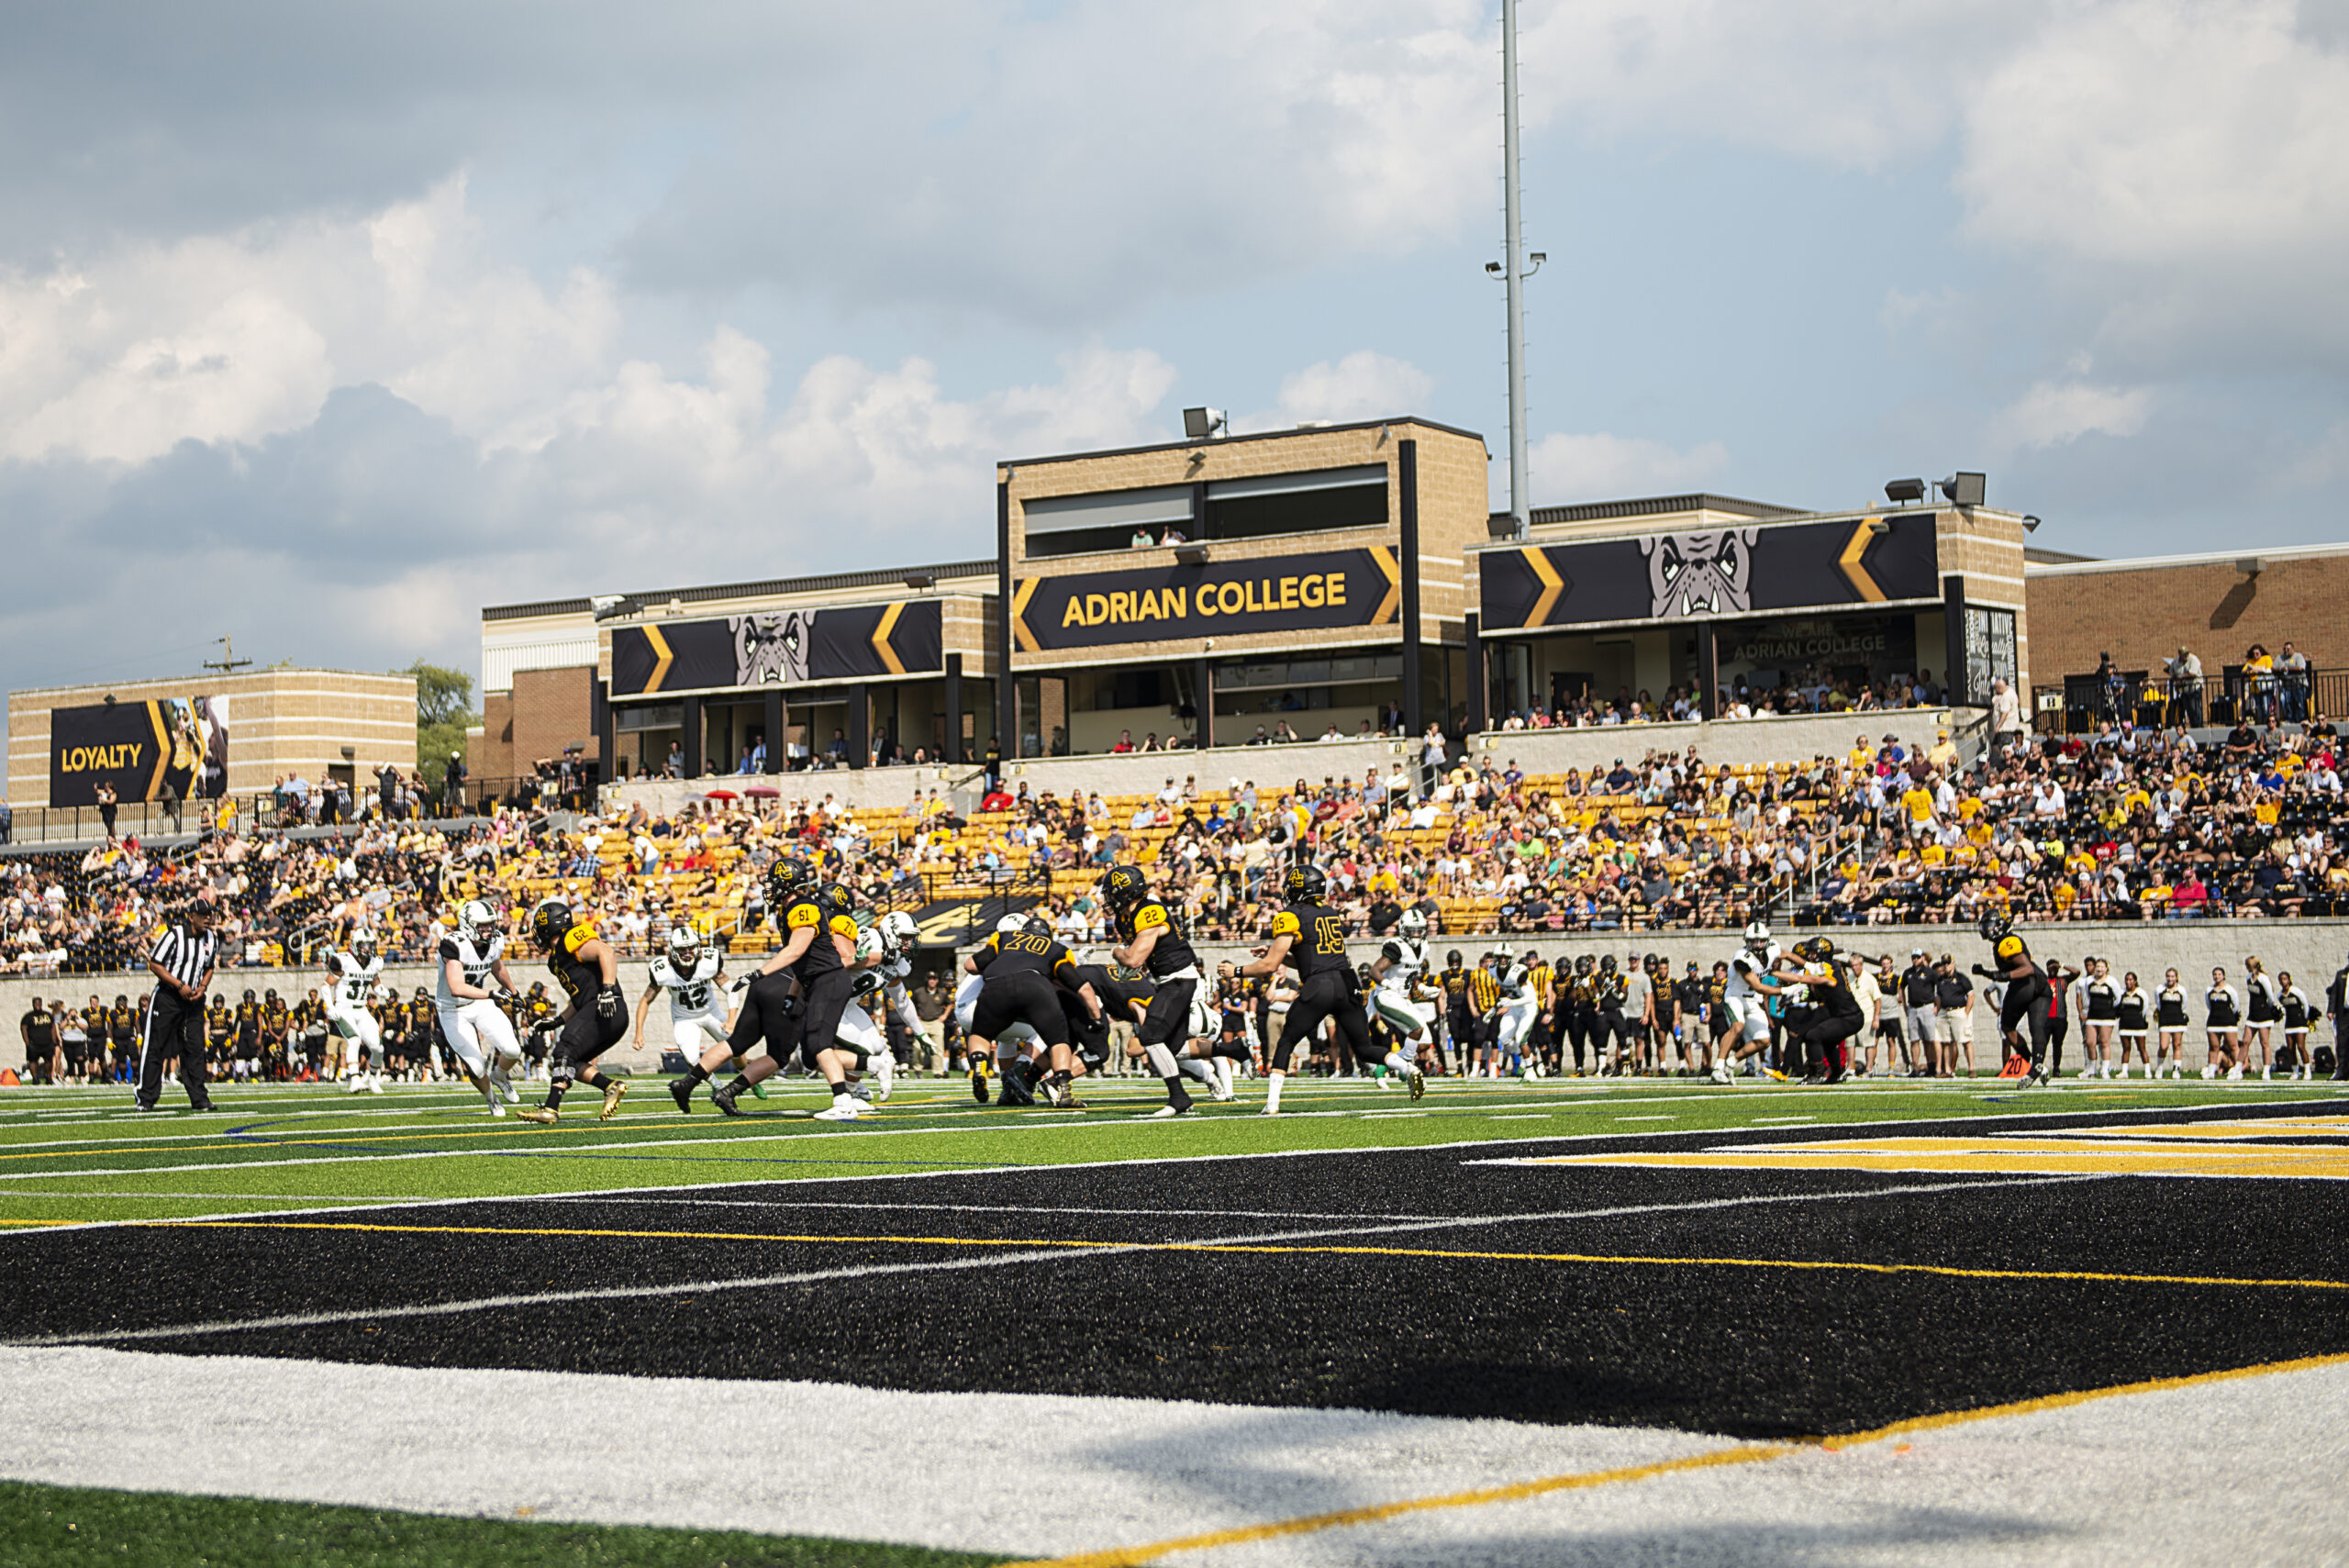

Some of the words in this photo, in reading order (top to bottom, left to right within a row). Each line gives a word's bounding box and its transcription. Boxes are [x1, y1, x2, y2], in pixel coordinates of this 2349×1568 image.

[1062, 586, 1186, 628] ADRIAN
[1195, 572, 1346, 617] COLLEGE
[1781, 622, 1801, 639] WE
[1807, 621, 1832, 637] ARE
[1733, 642, 1800, 661] ADRIAN
[1806, 635, 1885, 655] COLLEGE
[61, 743, 142, 773] LOYALTY
[1144, 909, 1159, 923] 22
[1275, 917, 1285, 930] 15
[573, 929, 588, 941] 62
[843, 921, 853, 935] 71
[1315, 916, 1344, 954] 15
[1004, 930, 1052, 955] 70
[2006, 940, 2013, 951] 5
[346, 980, 373, 1000] 37
[678, 986, 708, 1010] 42
[2007, 1057, 2022, 1075] 20
